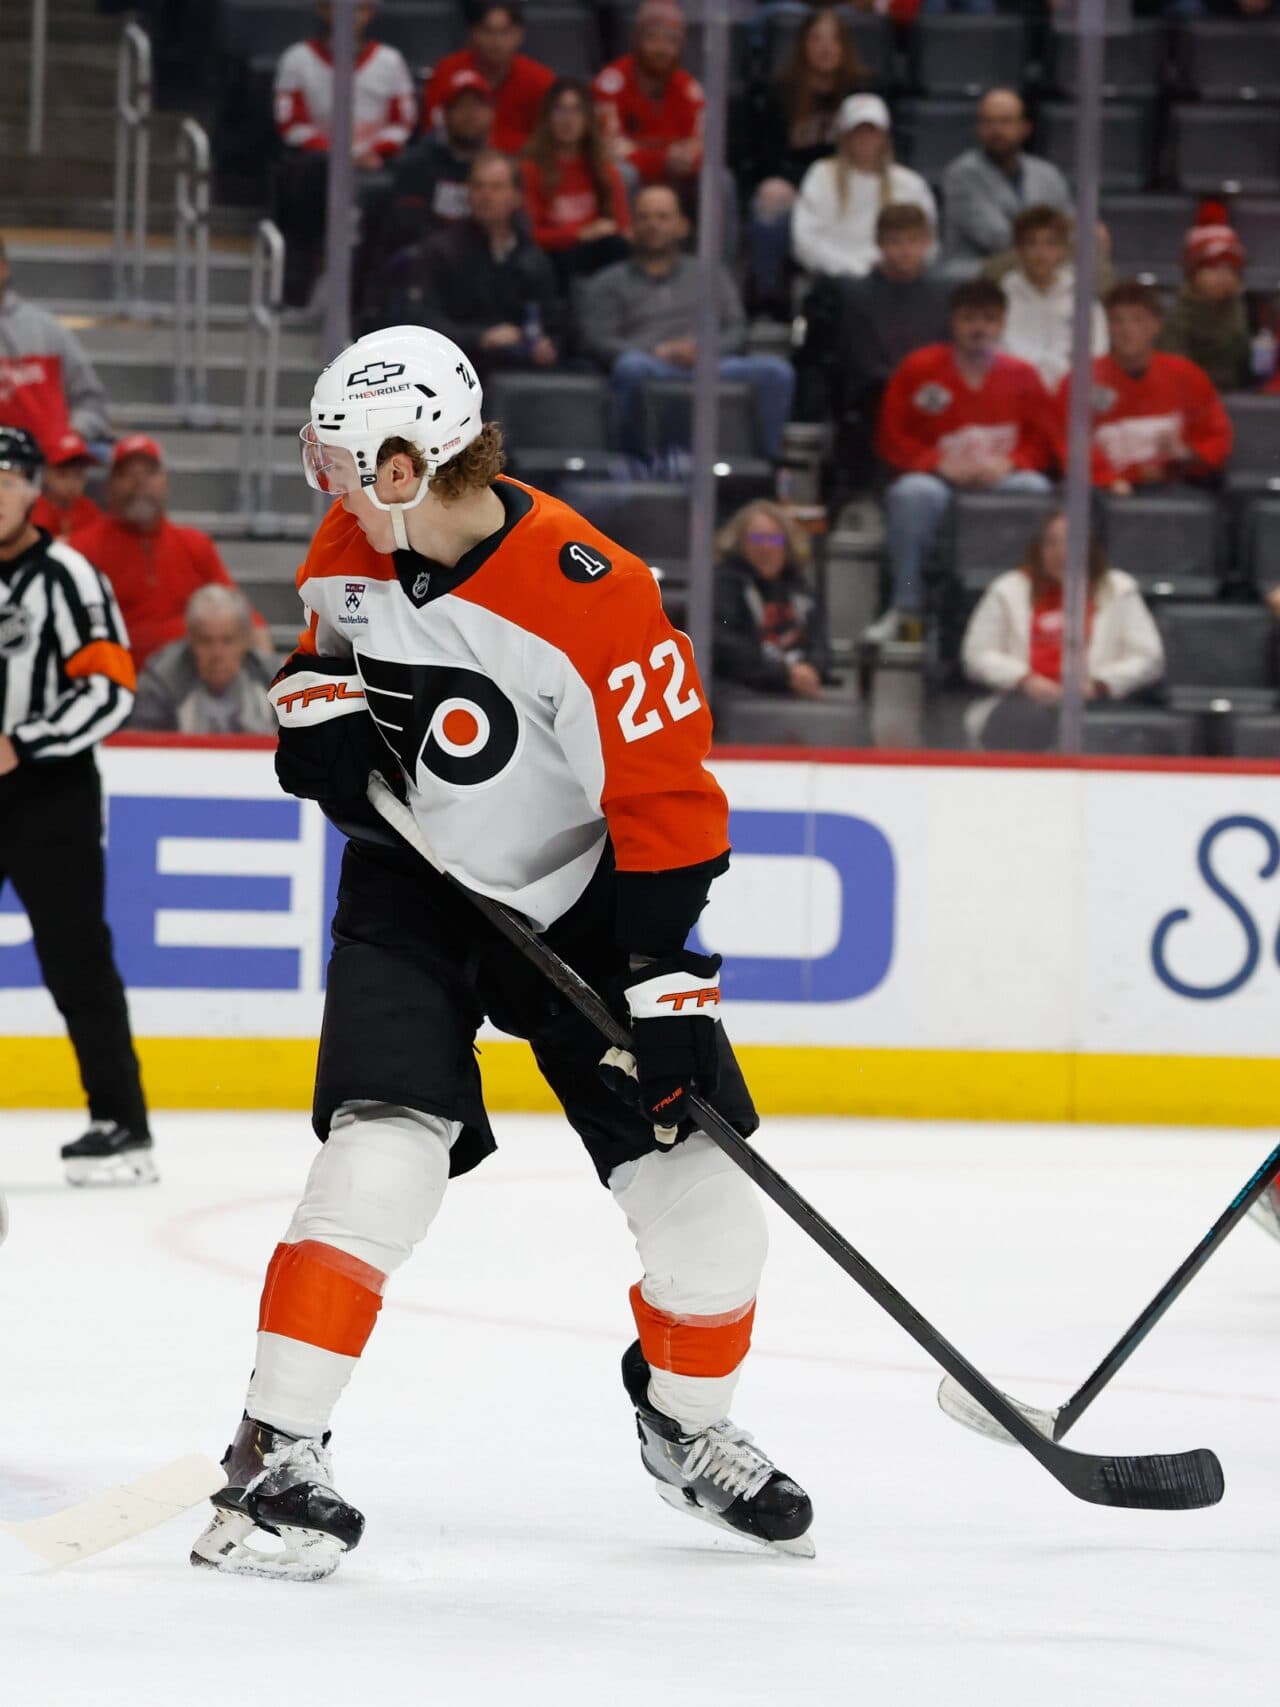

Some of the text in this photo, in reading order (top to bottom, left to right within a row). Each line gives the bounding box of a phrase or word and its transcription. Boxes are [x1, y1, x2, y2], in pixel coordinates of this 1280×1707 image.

[348, 382, 411, 401] CHEVROLET
[569, 544, 606, 577] 1
[276, 682, 367, 714] TRU
[607, 638, 702, 744] 22
[1150, 814, 1280, 1000] S
